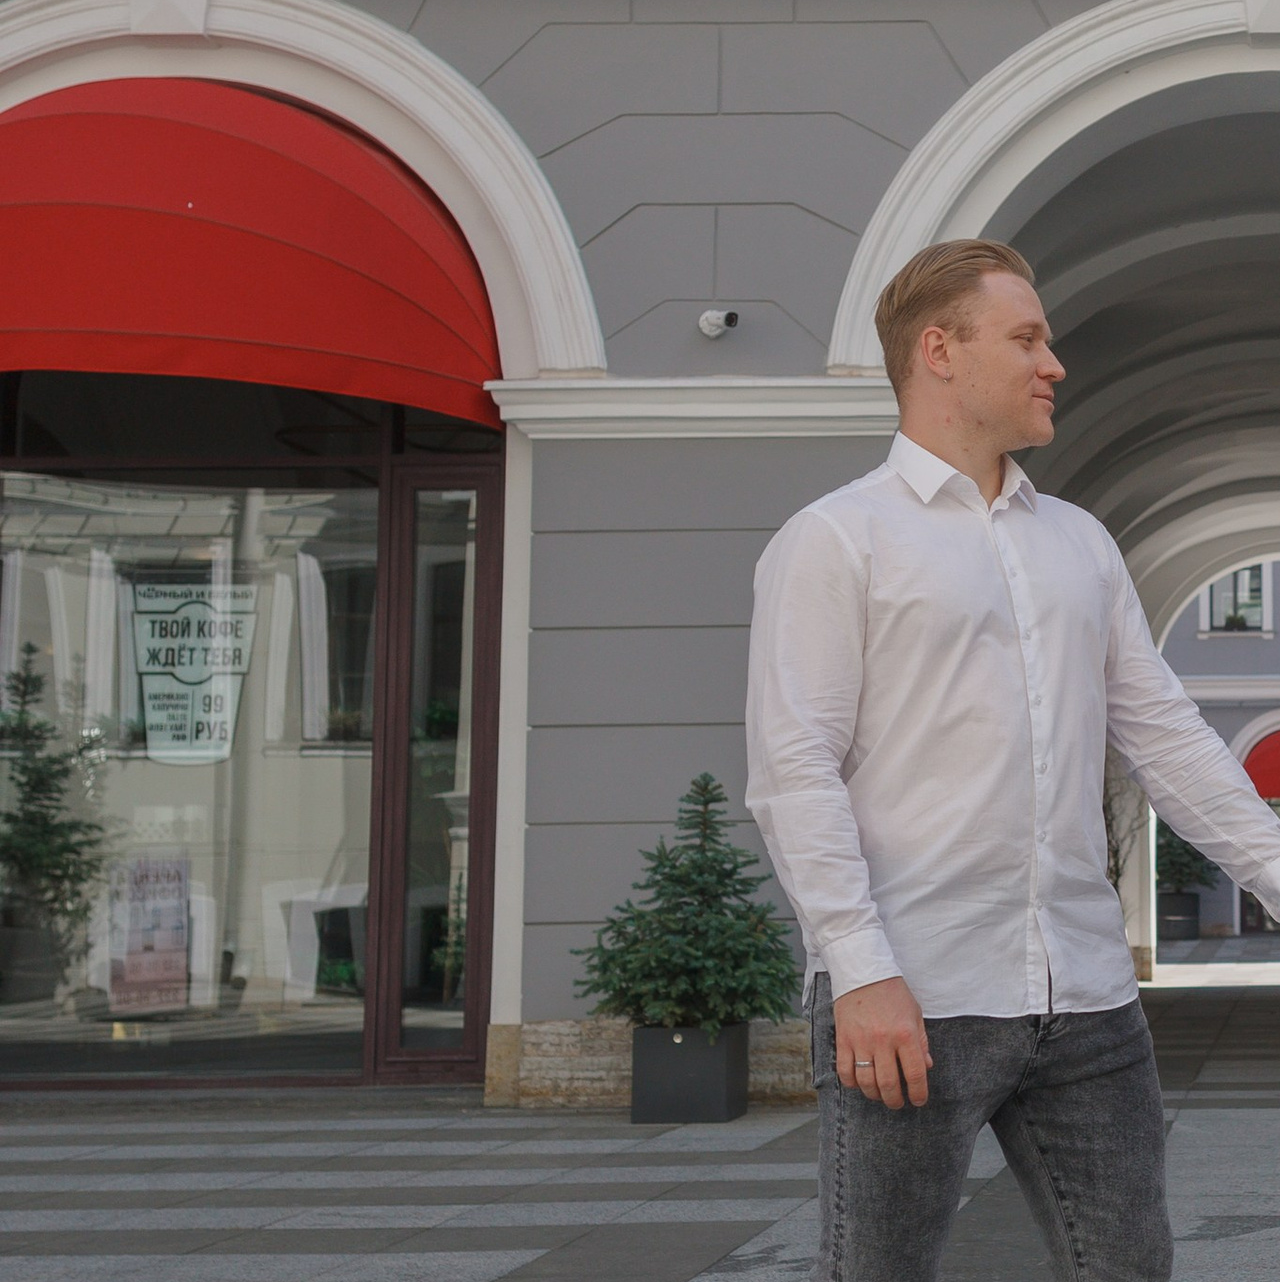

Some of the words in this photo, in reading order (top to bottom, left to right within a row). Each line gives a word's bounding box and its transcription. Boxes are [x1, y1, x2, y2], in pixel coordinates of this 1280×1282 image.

[149, 616, 191, 639] ТВОЙ
[197, 620, 243, 639] КОФЕ
[146, 643, 195, 667] ЖДЁТ
[202, 647, 242, 666] ТЕБЯ
[202, 694, 224, 714] 99
[195, 720, 228, 740] РУБ
